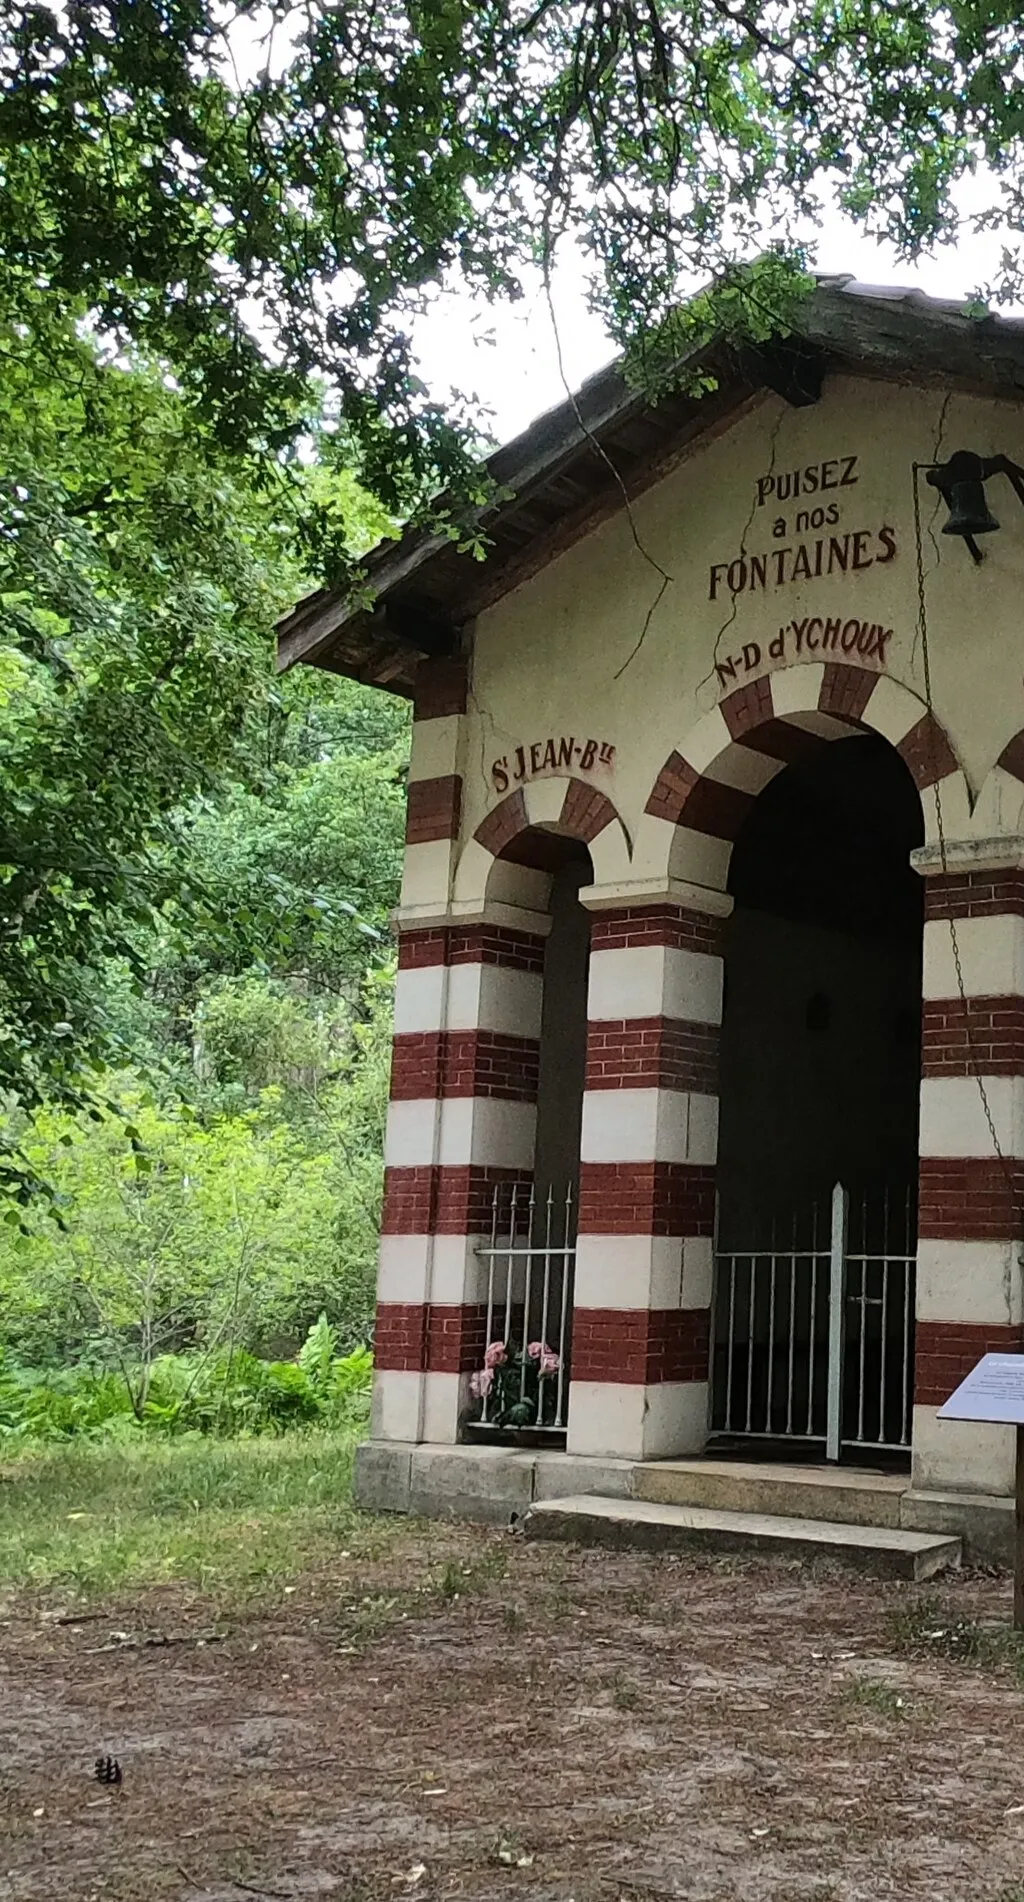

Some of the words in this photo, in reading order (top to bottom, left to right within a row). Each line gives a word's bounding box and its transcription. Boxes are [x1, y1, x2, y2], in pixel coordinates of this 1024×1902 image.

[757, 456, 859, 507] PUISEZ
[796, 503, 840, 533] nos
[708, 525, 897, 601] FONTAINES
[768, 617, 894, 663] d'YCHOUX
